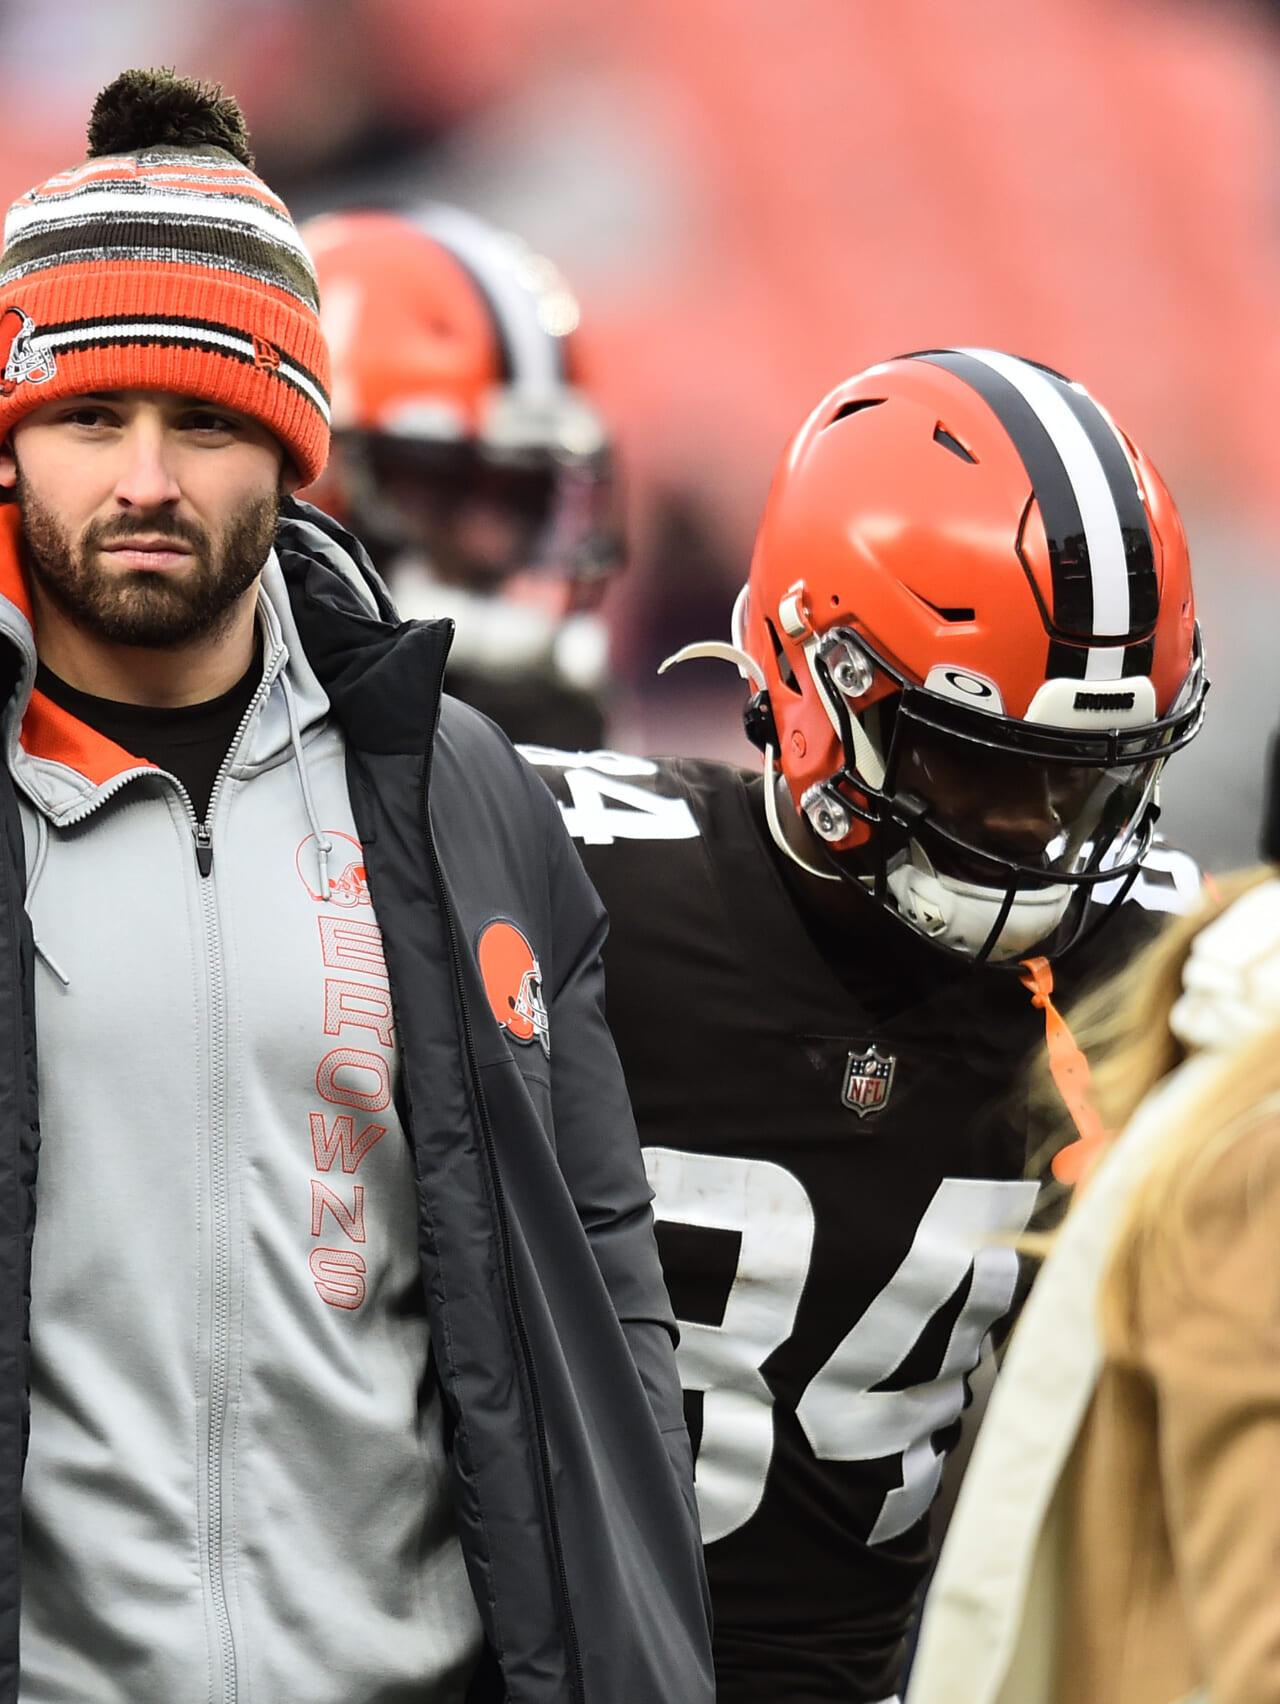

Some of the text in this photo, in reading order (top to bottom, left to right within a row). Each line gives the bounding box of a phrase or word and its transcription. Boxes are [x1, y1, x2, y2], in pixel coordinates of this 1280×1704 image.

[309, 915, 396, 1311] BROWNS
[847, 1077, 885, 1105] NFL
[641, 1146, 1042, 1547] 84
